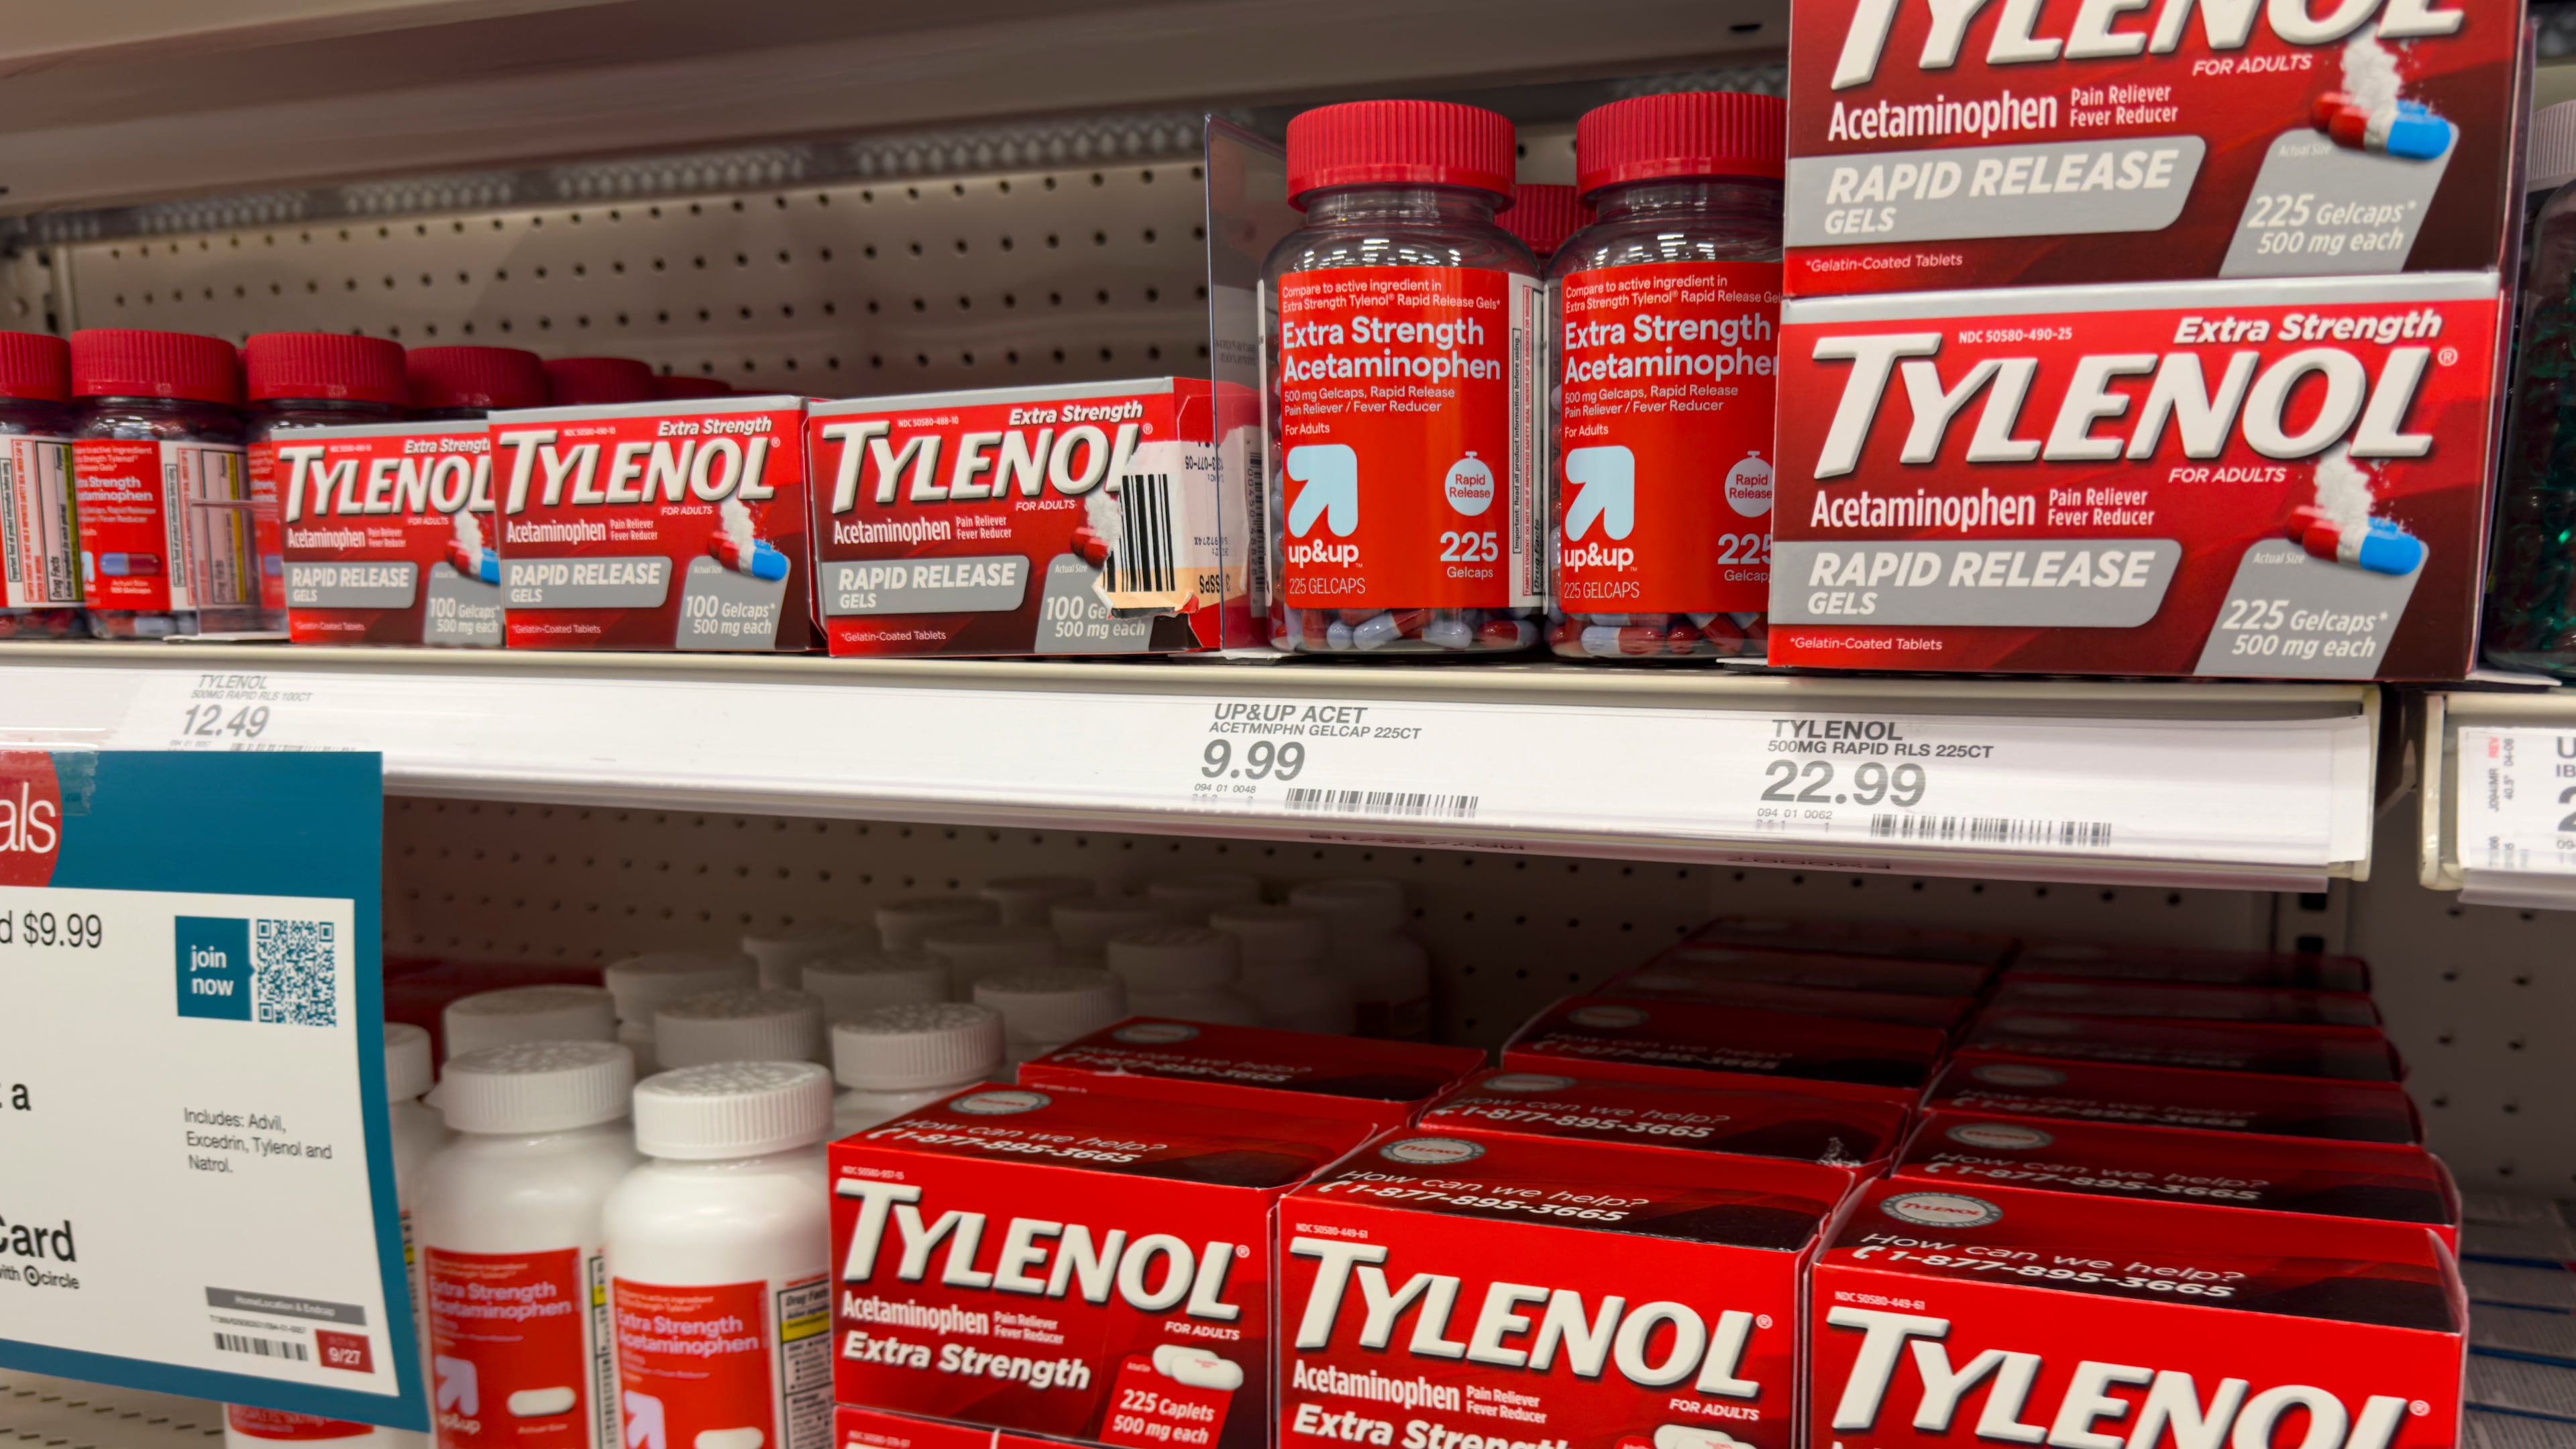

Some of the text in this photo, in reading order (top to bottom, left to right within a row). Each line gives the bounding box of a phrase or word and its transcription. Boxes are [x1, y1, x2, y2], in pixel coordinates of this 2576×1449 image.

[1828, 91, 2057, 141] Acetaminophen
[1826, 149, 2179, 204] RAPID RELEASE
[1825, 207, 1896, 234] GELS
[2247, 194, 2314, 227] 225
[2257, 228, 2404, 256] 500 mg each
[1283, 280, 1441, 299] Compare to active ingredient in
[1283, 301, 1301, 313] Extra
[1304, 297, 1346, 311] Strength
[1397, 294, 1430, 308] Rapid
[1433, 295, 1474, 308] Release
[1283, 317, 1483, 349] Extra Strength
[1566, 313, 1770, 350] Extra Strength
[1959, 327, 2072, 343] NDC 50580-490-25
[2174, 309, 2442, 344] Extra Strength
[1284, 348, 1501, 383] Acetaminophen
[1285, 386, 1454, 402] 500 mg Gelcaps, Rapid Release
[1010, 401, 1143, 425] Extra Strength
[1285, 400, 1442, 417] Pain Reliever Fever Reducer
[659, 417, 771, 437] Extra Strength
[898, 417, 959, 427] NDC 50580-488-10
[1285, 422, 1330, 435] For Adults
[278, 445, 495, 523] TYLENOL
[1455, 474, 1485, 486] Rapid
[2169, 468, 2286, 483] FOR ADULTS
[1449, 486, 1491, 498] Release
[2049, 489, 2147, 506] Pain Reliever
[1811, 488, 2035, 532] Acetaminophen
[2048, 508, 2155, 526] Fever Reducer
[506, 520, 606, 544] Acetaminophen
[834, 517, 951, 545] Acetaminophen
[1440, 531, 1498, 562] 225
[292, 568, 409, 587] RAPID RELEASE
[511, 563, 661, 586] RAPID RELEASE
[839, 563, 1016, 591] RAPID RELEASE
[1447, 566, 1493, 580] Gelcaps
[1809, 551, 2155, 587] RAPID RELEASE
[1289, 578, 1365, 594] 225 GELCAPS
[687, 595, 718, 618] 100
[840, 593, 877, 609] GELS
[1046, 596, 1083, 620] 100
[1807, 591, 1877, 614] GELS
[2222, 600, 2288, 631] 225
[1896, 638, 1943, 650] Tablets
[2233, 635, 2375, 659] 500 mg each
[199, 675, 268, 690] TYLENOL
[183, 704, 270, 738] 12.49
[1215, 703, 1368, 724] UP&UP ACET
[1209, 722, 1421, 739] ACETMNPHN GELCAP 225CT
[1772, 719, 1902, 741] TYLENOL
[1201, 739, 1305, 781] 9.99
[1768, 740, 1994, 759] 500MG RAPID RLS 225CT
[1195, 784, 1256, 794] 094 01 0048
[1760, 759, 1926, 807] 22.99
[1805, 809, 1833, 820] 0062
[23, 911, 102, 949] $9.99
[190, 945, 227, 972] join
[191, 977, 233, 997] now
[12, 1082, 31, 1112] a
[184, 1108, 286, 1133] Includes: Advil,
[1461, 1107, 1715, 1138] 1-877-895-3665
[186, 1131, 332, 1159] Excedrin, Tylenol and
[895, 1131, 1142, 1163] 1-877-895-3665
[189, 1155, 233, 1173] Natrol.
[1336, 1170, 1650, 1208] How can we help?
[1348, 1184, 1629, 1222] 1-877-895-3665
[1860, 1233, 2247, 1283] How can we help?
[1888, 1250, 2236, 1298] 1-877-895-3665
[843, 1291, 989, 1336] Acetaminophen
[327, 1346, 362, 1365] 9/27
[843, 1331, 1091, 1390] Extra Strength
[1293, 1360, 1460, 1411] Acetaminophen
[1119, 1388, 1215, 1423] 225 Caplets
[1113, 1414, 1209, 1444] 500 mg each
